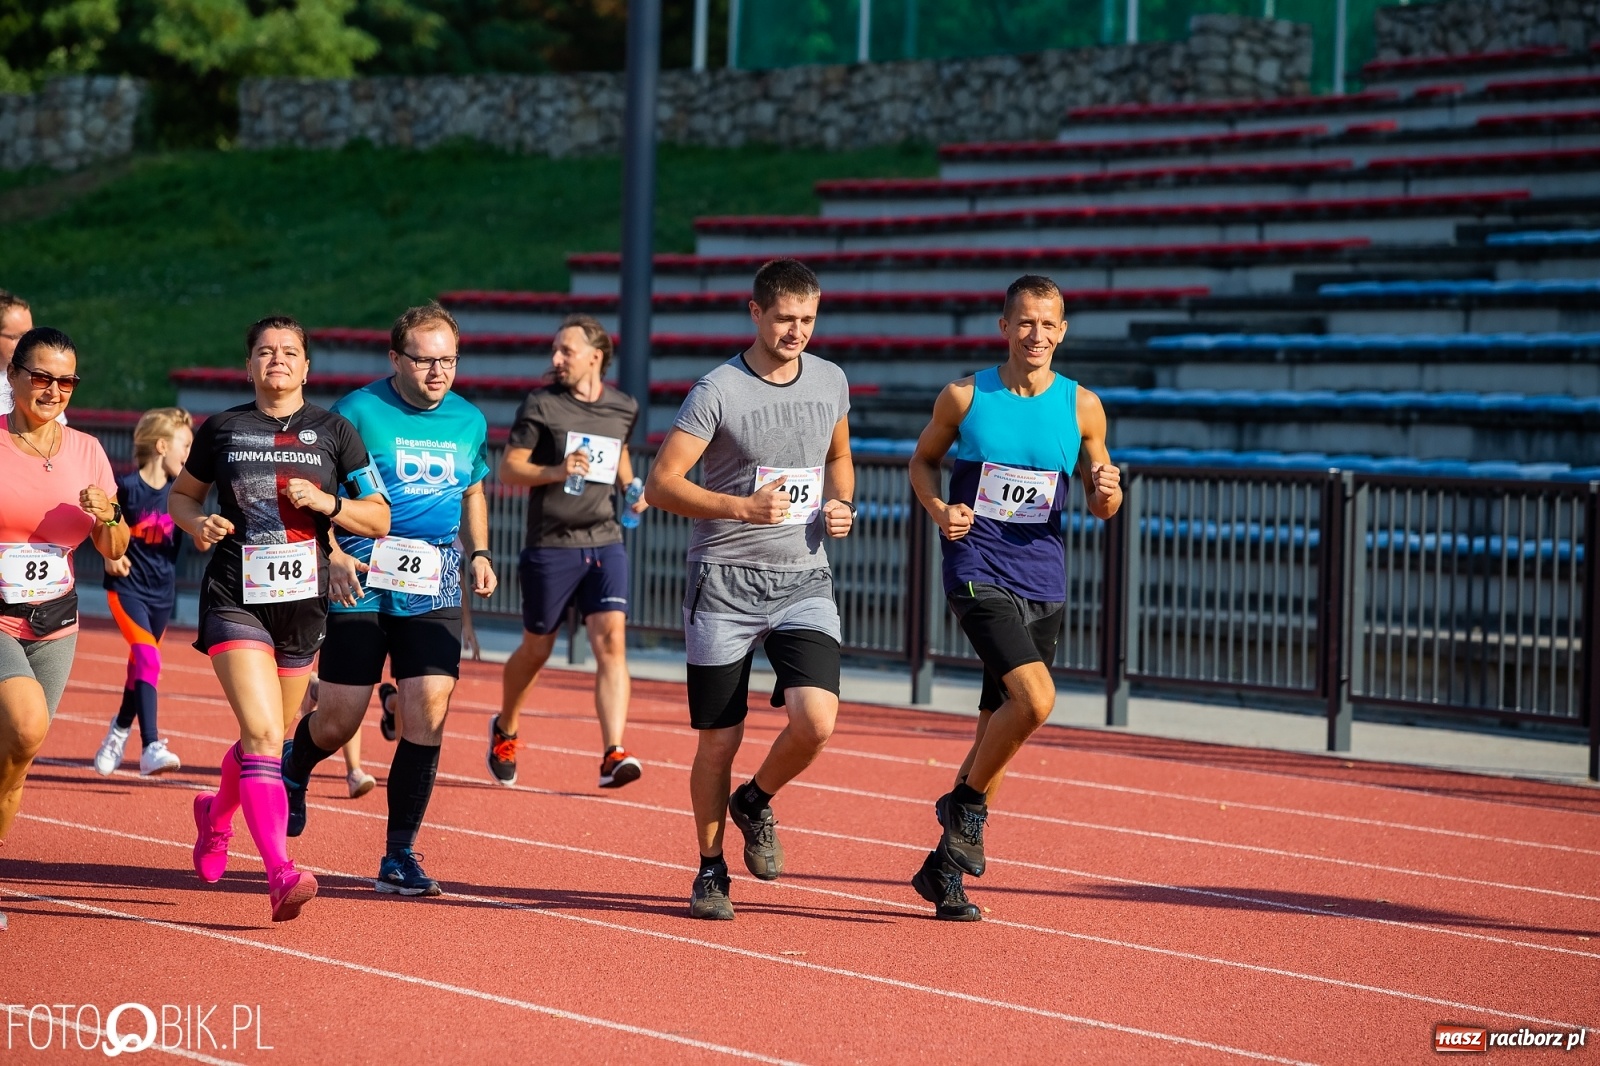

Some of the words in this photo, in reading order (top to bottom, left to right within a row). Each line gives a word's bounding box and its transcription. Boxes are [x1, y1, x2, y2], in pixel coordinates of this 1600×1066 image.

[227, 451, 322, 467] RUNMAGEDDON
[1002, 483, 1037, 504] 102
[25, 560, 49, 581] 83
[267, 560, 302, 581] 148
[397, 555, 422, 574] 28
